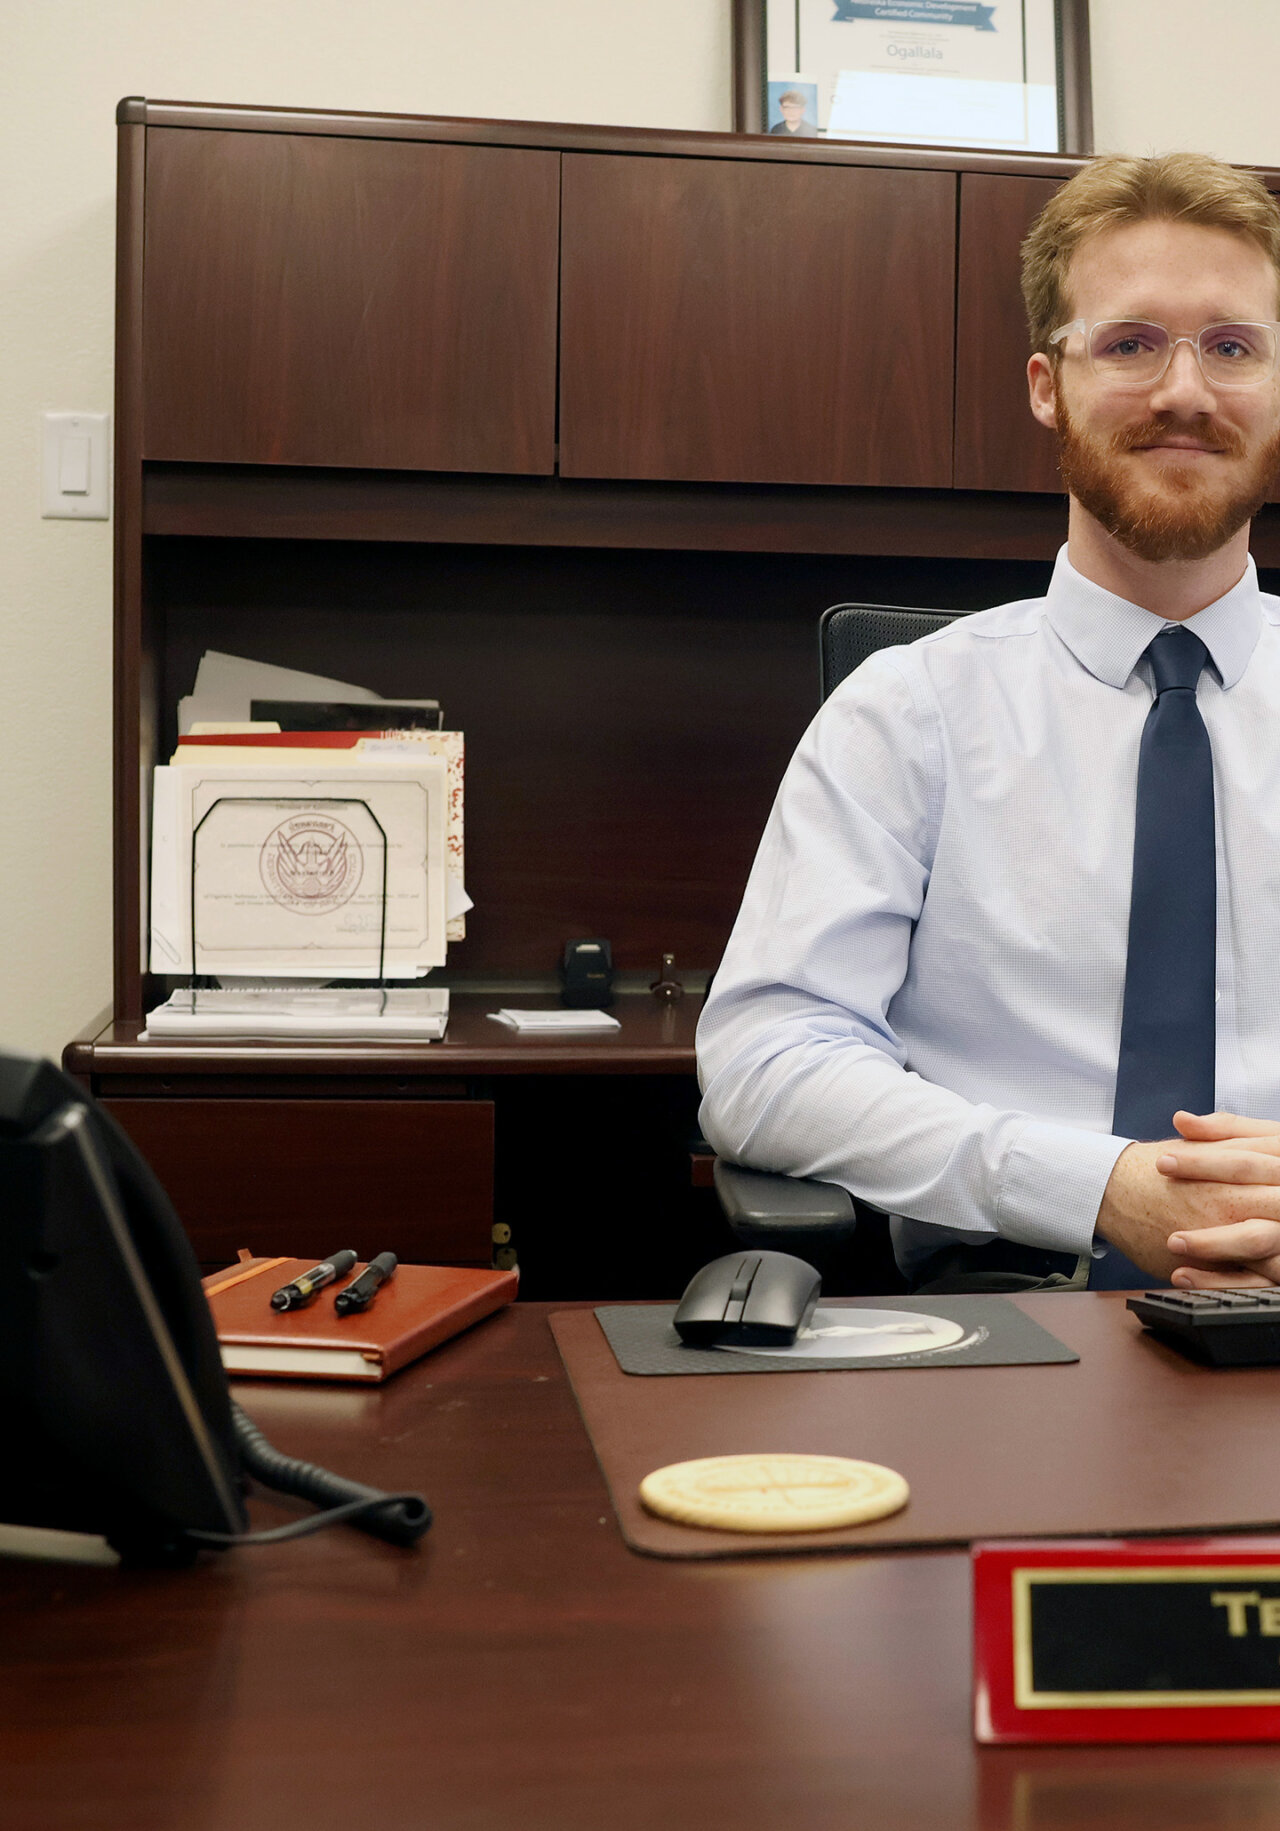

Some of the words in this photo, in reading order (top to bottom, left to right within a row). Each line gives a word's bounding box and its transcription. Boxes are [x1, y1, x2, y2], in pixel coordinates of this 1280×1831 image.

[926, 1, 977, 11] Development
[874, 8, 907, 17] Certified
[908, 9, 953, 21] Community
[886, 44, 943, 60] Ogallala
